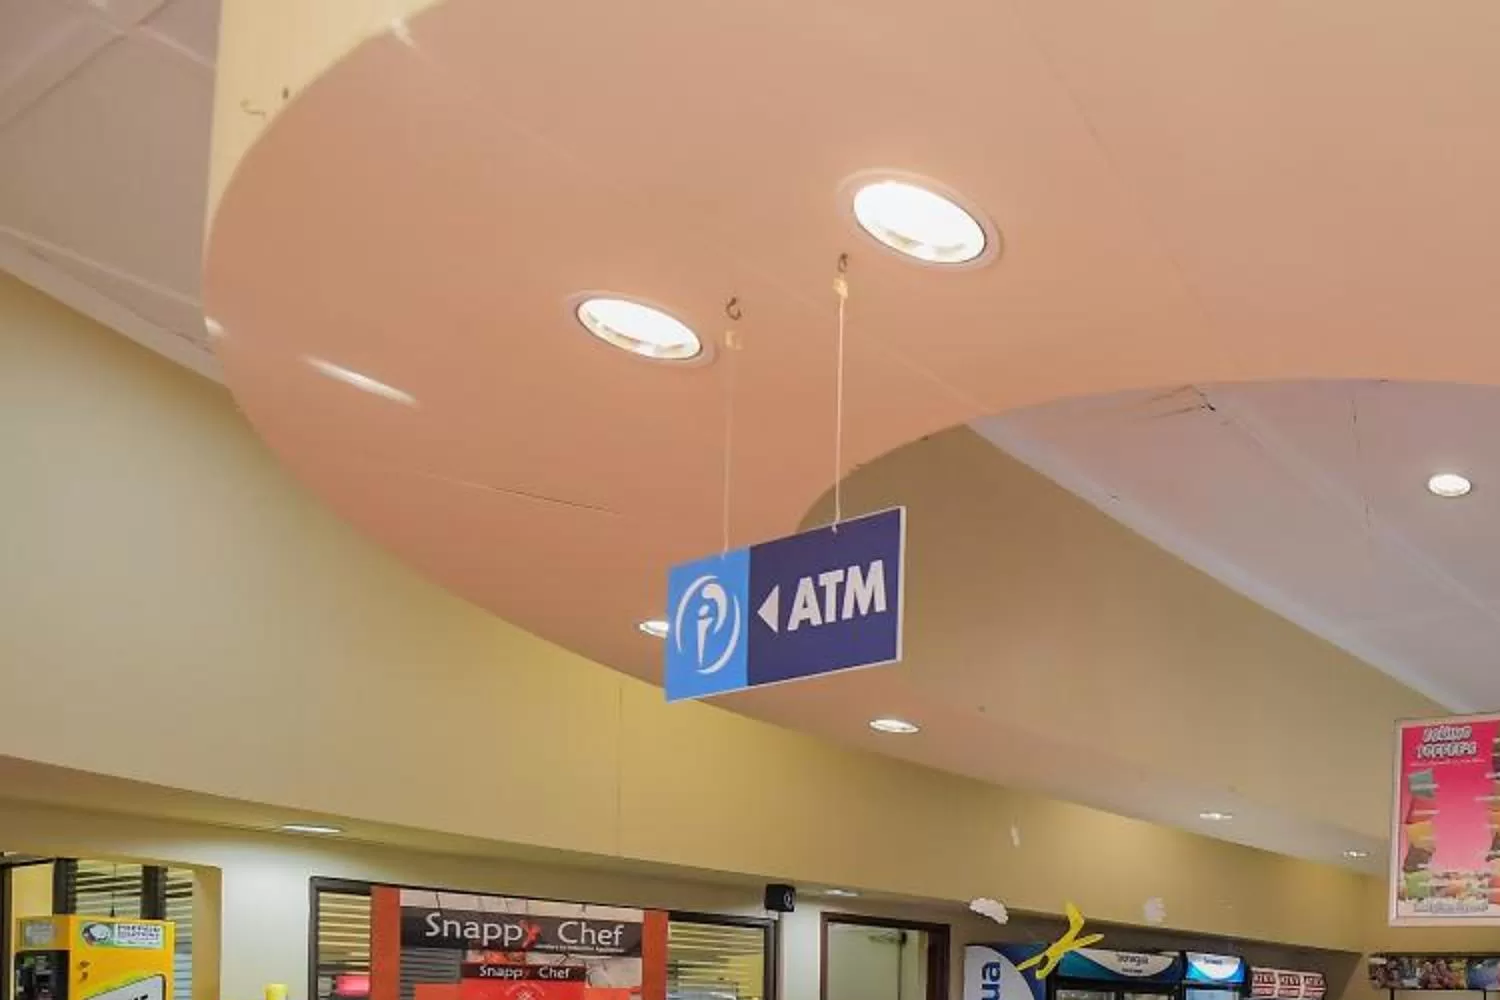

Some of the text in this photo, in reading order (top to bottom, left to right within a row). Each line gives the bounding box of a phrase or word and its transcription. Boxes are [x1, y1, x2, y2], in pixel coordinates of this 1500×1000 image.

[788, 560, 887, 631] ATM
[425, 912, 625, 949] Snappy Chef
[479, 965, 570, 980] Snappy Chef
